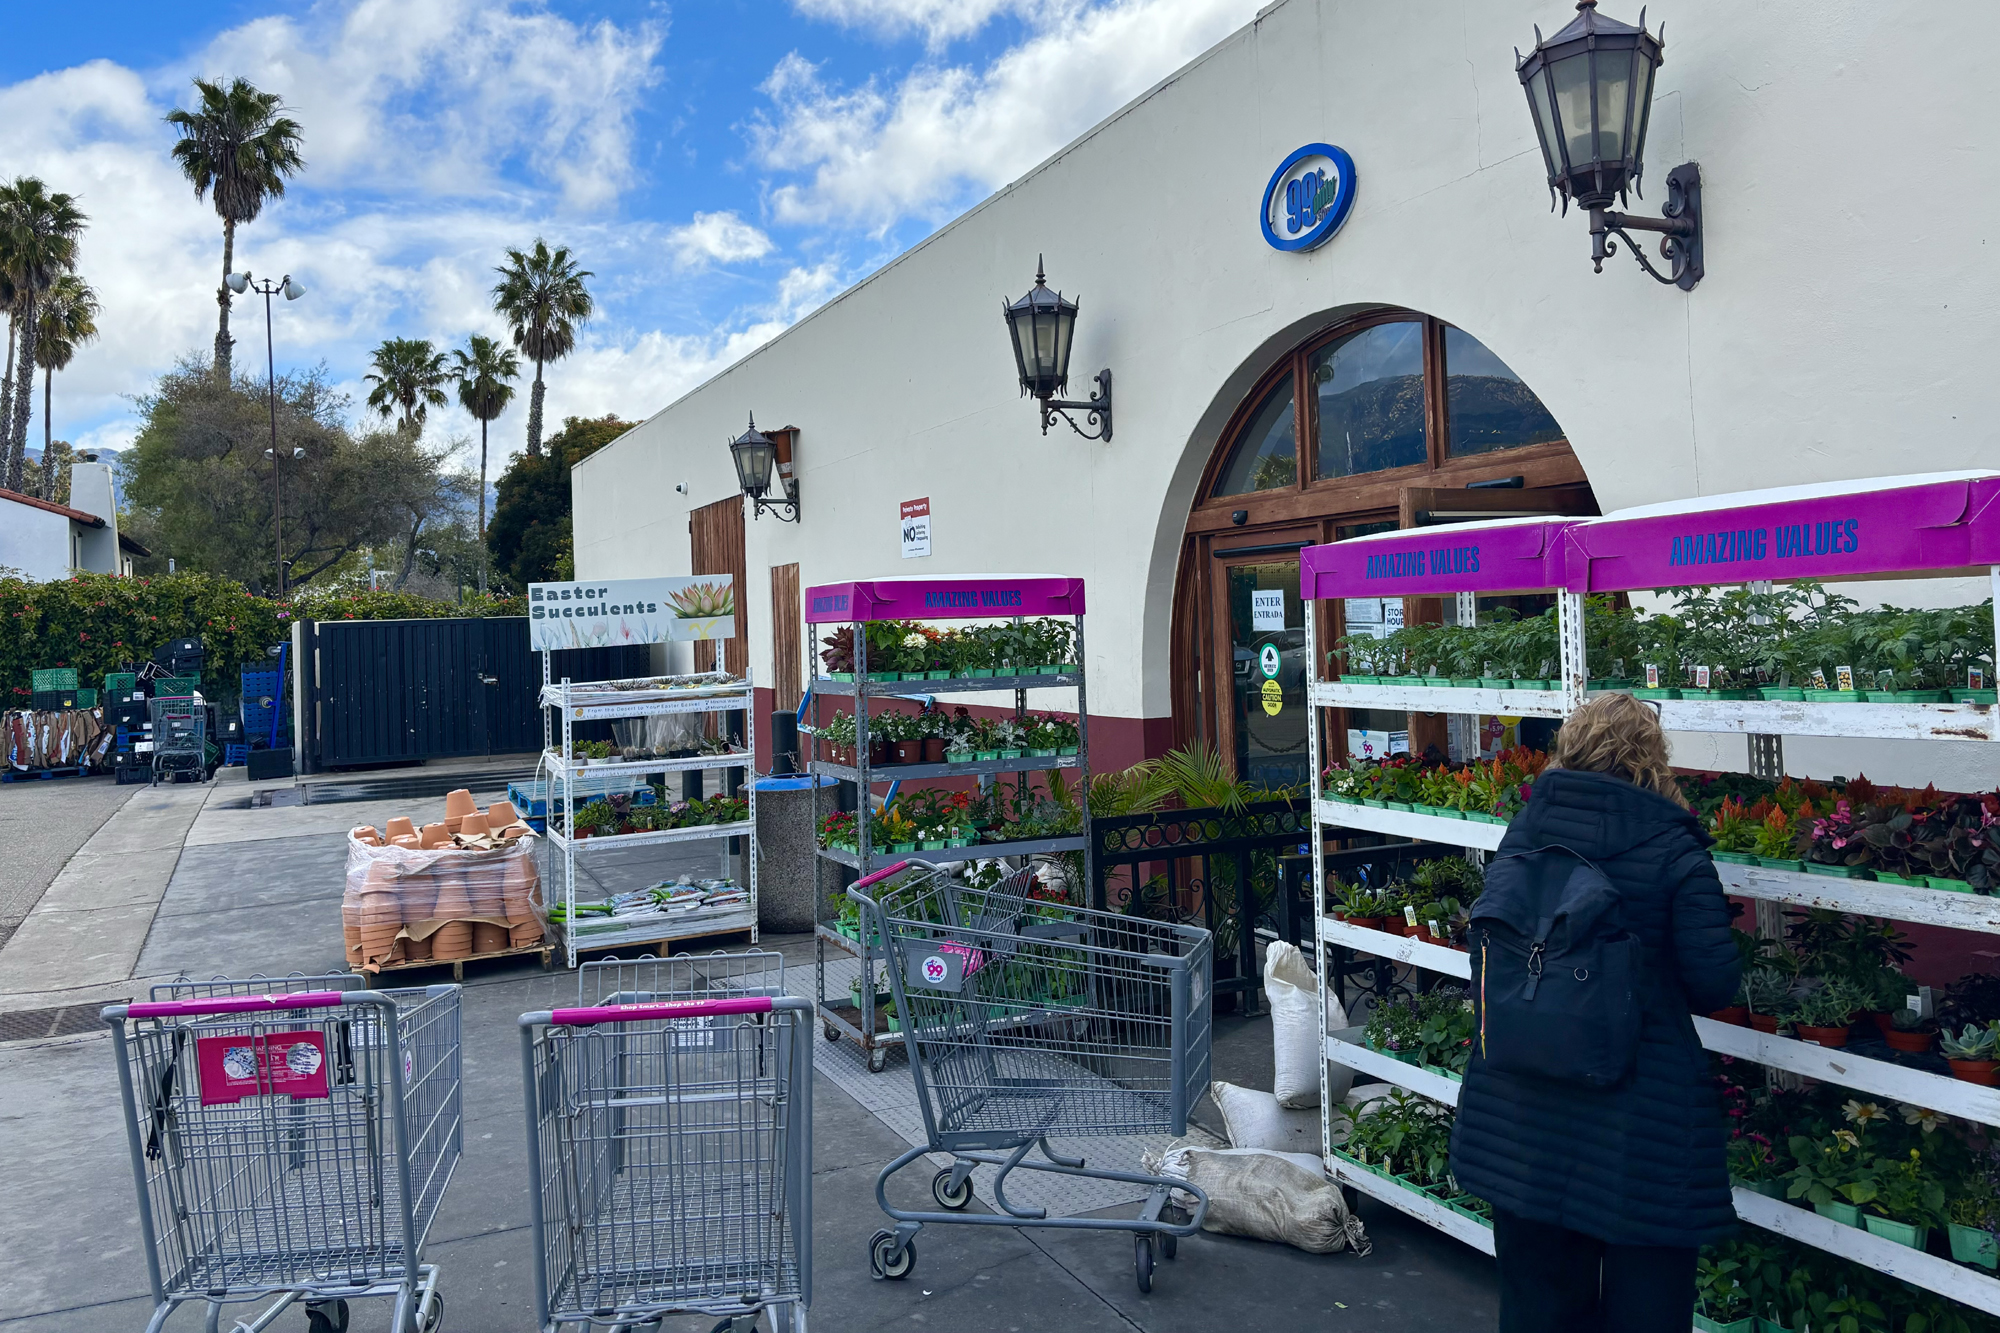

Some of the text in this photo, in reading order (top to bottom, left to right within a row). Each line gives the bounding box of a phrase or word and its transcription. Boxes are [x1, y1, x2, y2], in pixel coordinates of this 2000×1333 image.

[903, 526, 916, 543] NO
[1669, 518, 1859, 566] AMAZING VALUES
[1366, 546, 1480, 579] AMAZING VALUES
[531, 587, 608, 602] Easter
[925, 590, 1022, 608] AMAZING VALUES
[1255, 597, 1281, 607] ENTER
[531, 601, 657, 619] Succulents
[1254, 610, 1283, 619] ENTRADA
[1388, 608, 1404, 616] STOR
[1387, 617, 1404, 626] HOUR
[927, 964, 943, 976] 99
